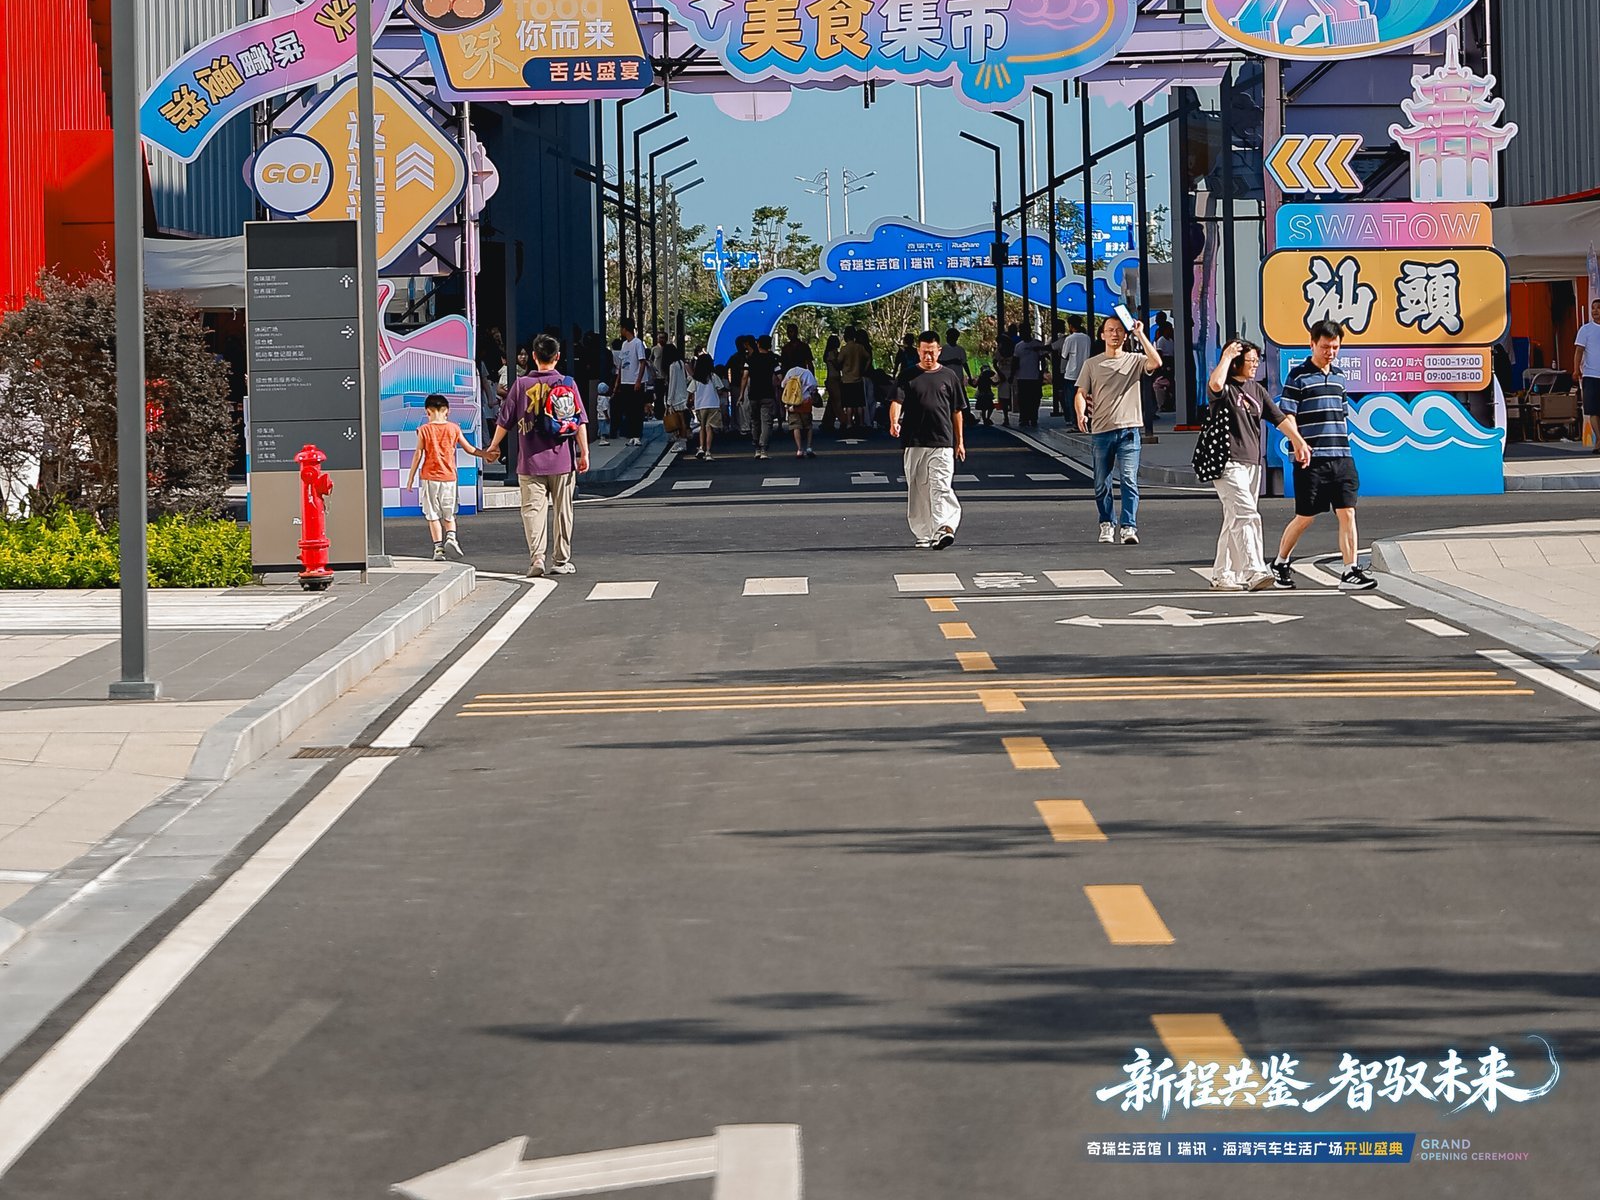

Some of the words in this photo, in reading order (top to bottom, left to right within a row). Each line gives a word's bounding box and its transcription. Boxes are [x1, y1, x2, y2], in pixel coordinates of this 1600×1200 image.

[515, 19, 615, 51] 你而来
[549, 61, 640, 82] 舌尖盛宴
[261, 163, 322, 184] GO!
[1288, 213, 1481, 242] SWATOW
[1303, 256, 1464, 336] 汕頭
[1374, 358, 1403, 367] 06.20
[1405, 358, 1423, 367] 周六
[1427, 357, 1480, 366] 10:00-19:00
[1374, 371, 1403, 381] 06.21
[1405, 371, 1422, 381] 周日
[1426, 371, 1481, 380] 09:00-18:00
